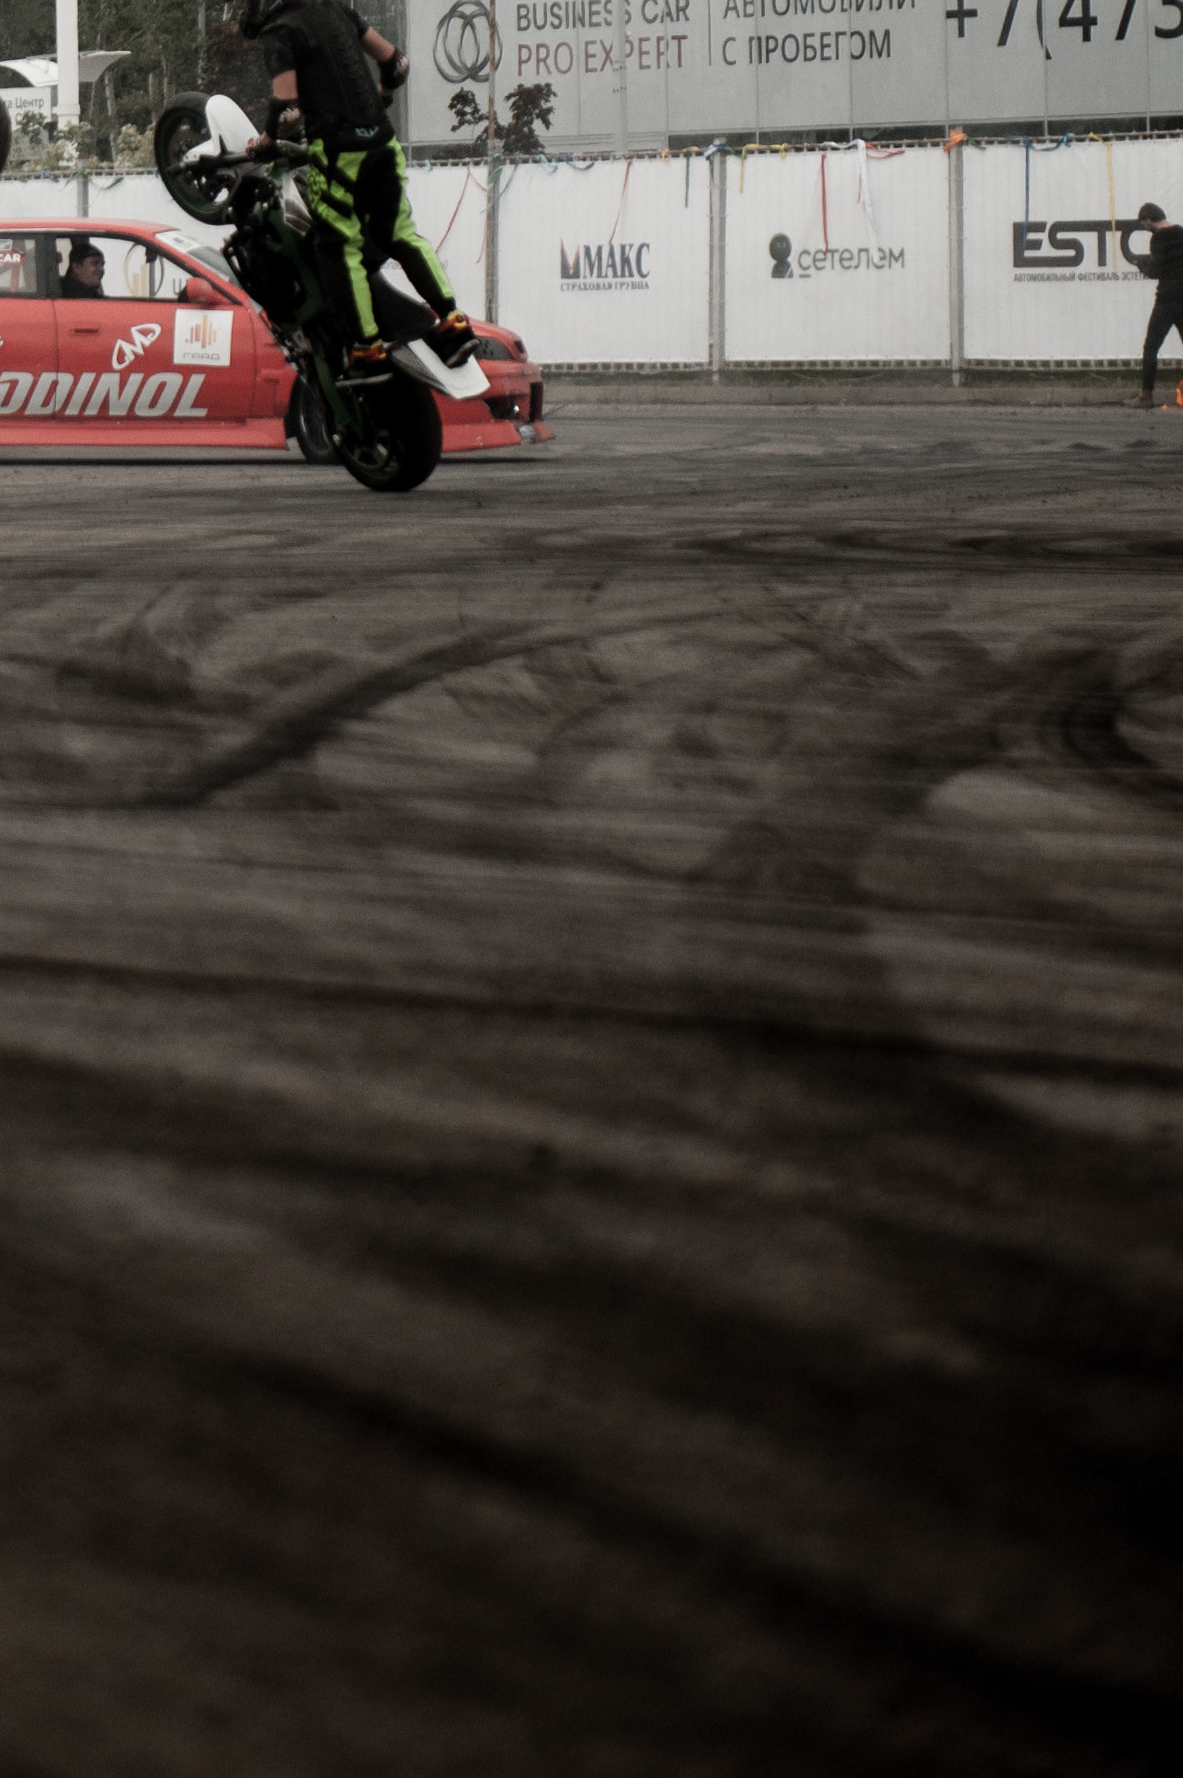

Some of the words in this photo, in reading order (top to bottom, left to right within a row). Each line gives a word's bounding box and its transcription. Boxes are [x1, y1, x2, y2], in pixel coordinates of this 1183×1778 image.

[517, 40, 574, 77] PRO
[584, 34, 689, 73] EXPERT
[721, 36, 738, 66] С
[748, 28, 892, 65] ПРОБЕГОМ
[582, 242, 651, 279] МАКС
